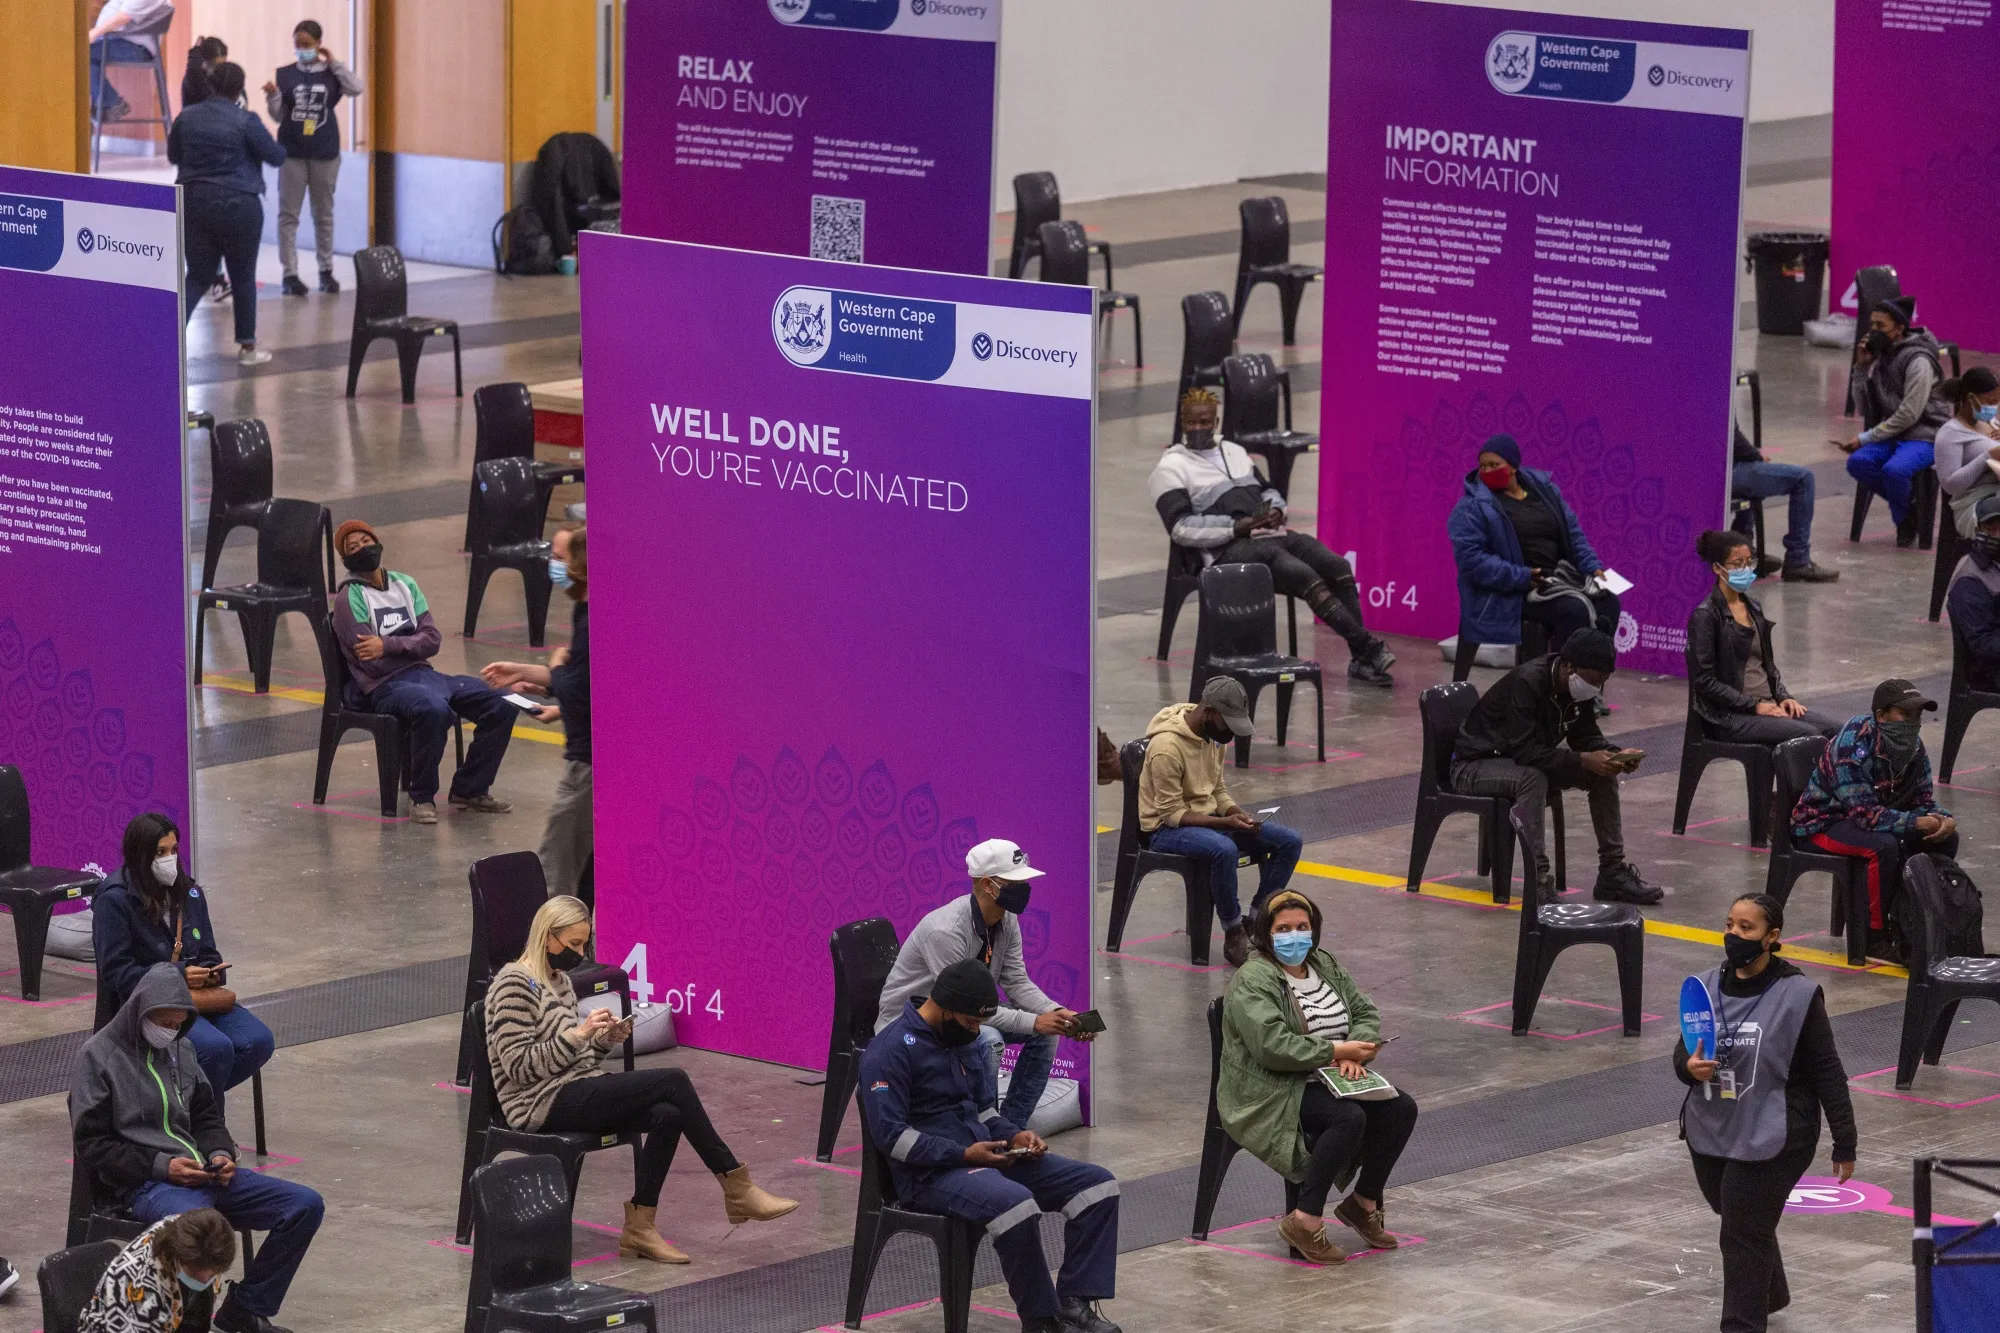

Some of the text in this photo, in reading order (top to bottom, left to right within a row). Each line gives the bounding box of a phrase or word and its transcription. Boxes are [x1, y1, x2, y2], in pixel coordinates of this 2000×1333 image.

[928, 1, 987, 20] Discovery
[1541, 41, 1620, 60] Western Cape
[678, 55, 754, 84] RELAX
[1540, 56, 1610, 73] Government
[1667, 70, 1733, 92] Discovery
[677, 84, 808, 118] AND ENJOY
[1386, 125, 1537, 164] IMPORTANT
[1385, 156, 1559, 198] INFORMATION
[18, 204, 47, 220] Cape
[0, 221, 38, 235] nment
[1536, 214, 1642, 233] Your body takes time to build
[97, 234, 164, 261] Discovery
[1536, 227, 1570, 238] immunity.
[1572, 230, 1598, 241] People
[1613, 236, 1653, 247] considered
[1655, 239, 1670, 250] fully
[1536, 240, 1669, 260] vaccinated only two weeks after their
[1535, 251, 1548, 259] last
[1549, 252, 1567, 261] dose
[1578, 255, 1590, 264] the
[1592, 257, 1626, 268] COVID-19
[1628, 262, 1658, 271] vaccine.
[838, 300, 935, 324] Western Cape
[838, 318, 923, 341] Government
[838, 351, 867, 364] Health
[996, 340, 1078, 367] Discovery
[15, 408, 34, 417] takes
[36, 410, 52, 420] time
[55, 413, 62, 421] to
[64, 414, 83, 424] build
[14, 421, 38, 432] People
[41, 426, 52, 434] are
[54, 429, 95, 440] considered
[97, 433, 113, 444] fully
[650, 403, 848, 464] WELL DONE,
[18, 436, 33, 447] only
[35, 438, 49, 447] two
[51, 442, 74, 451] weeks
[76, 444, 93, 454] after
[95, 447, 112, 457] their
[11, 449, 19, 457] of
[21, 450, 32, 459] the
[35, 452, 69, 464] COVID-19
[72, 459, 101, 469] vaccine.
[651, 442, 968, 512] YOU'RE VACCINATED
[4, 491, 35, 501] continue
[37, 494, 45, 503] to
[47, 496, 62, 506] take
[65, 499, 73, 507] all
[75, 500, 87, 509] the
[32, 479, 49, 489] have
[51, 482, 69, 492] been
[71, 487, 112, 501] vaccinated,
[16, 505, 38, 517] safety
[40, 510, 85, 524] precautions,
[15, 520, 33, 529] mask
[35, 523, 66, 535] wearing,
[68, 526, 86, 537] hand
[0, 545, 12, 553] ce.
[11, 533, 24, 541] and
[26, 536, 69, 550] maintaining
[71, 542, 100, 553] physical
[1368, 581, 1396, 609] of
[1401, 585, 1418, 612] 4
[620, 942, 725, 1021] 4 of 4
[1050, 1068, 1069, 1078] KAPA
